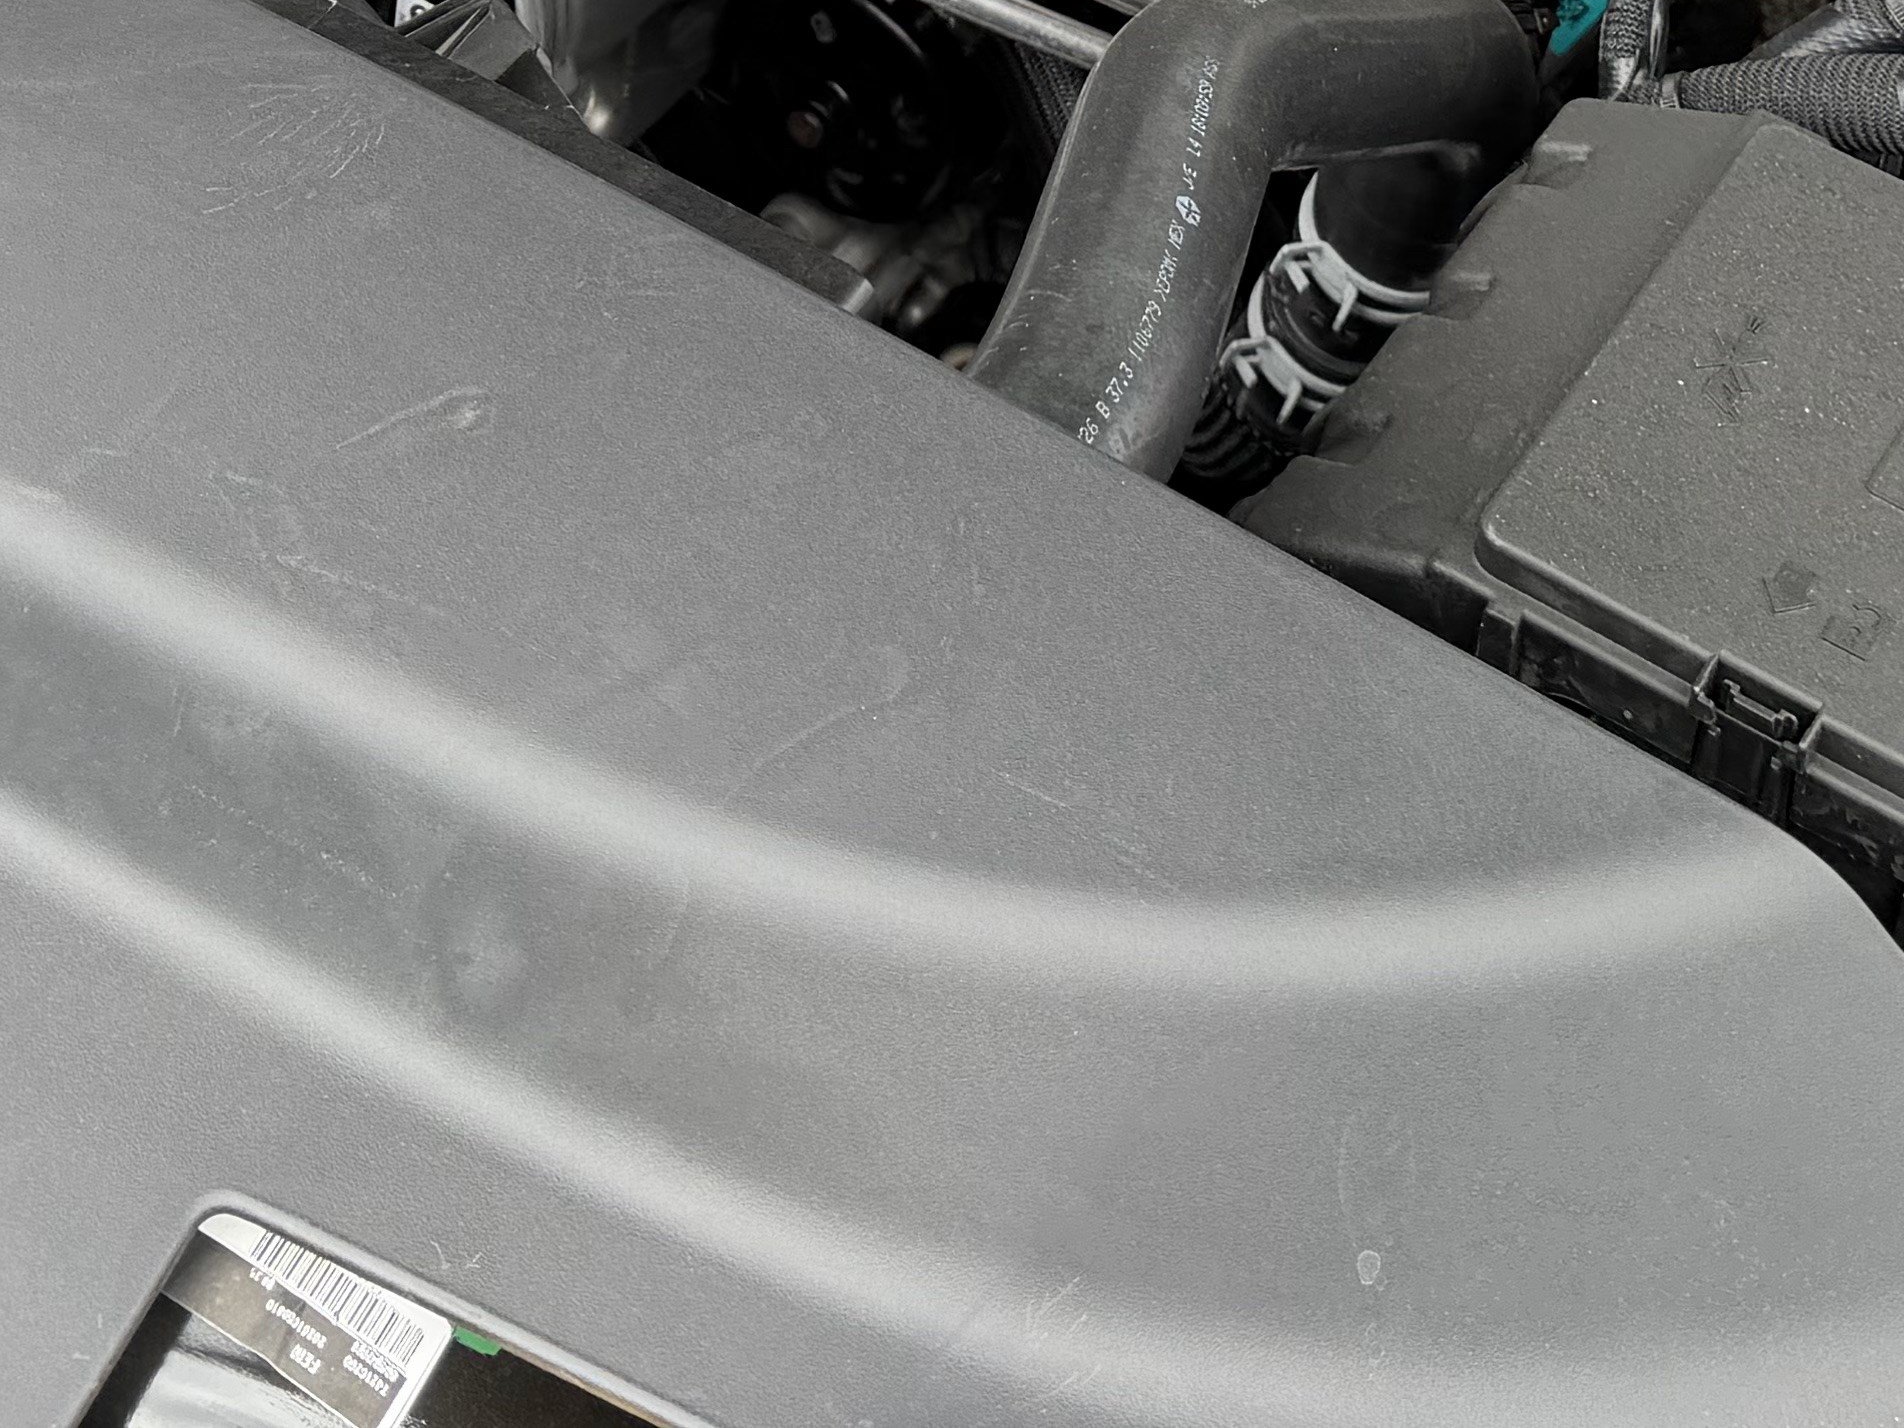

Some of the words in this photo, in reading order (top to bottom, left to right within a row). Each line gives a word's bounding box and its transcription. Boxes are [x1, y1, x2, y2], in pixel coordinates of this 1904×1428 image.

[1095, 400, 1110, 419] B
[1106, 361, 1134, 403] 37.3
[1128, 299, 1162, 362] 1106779
